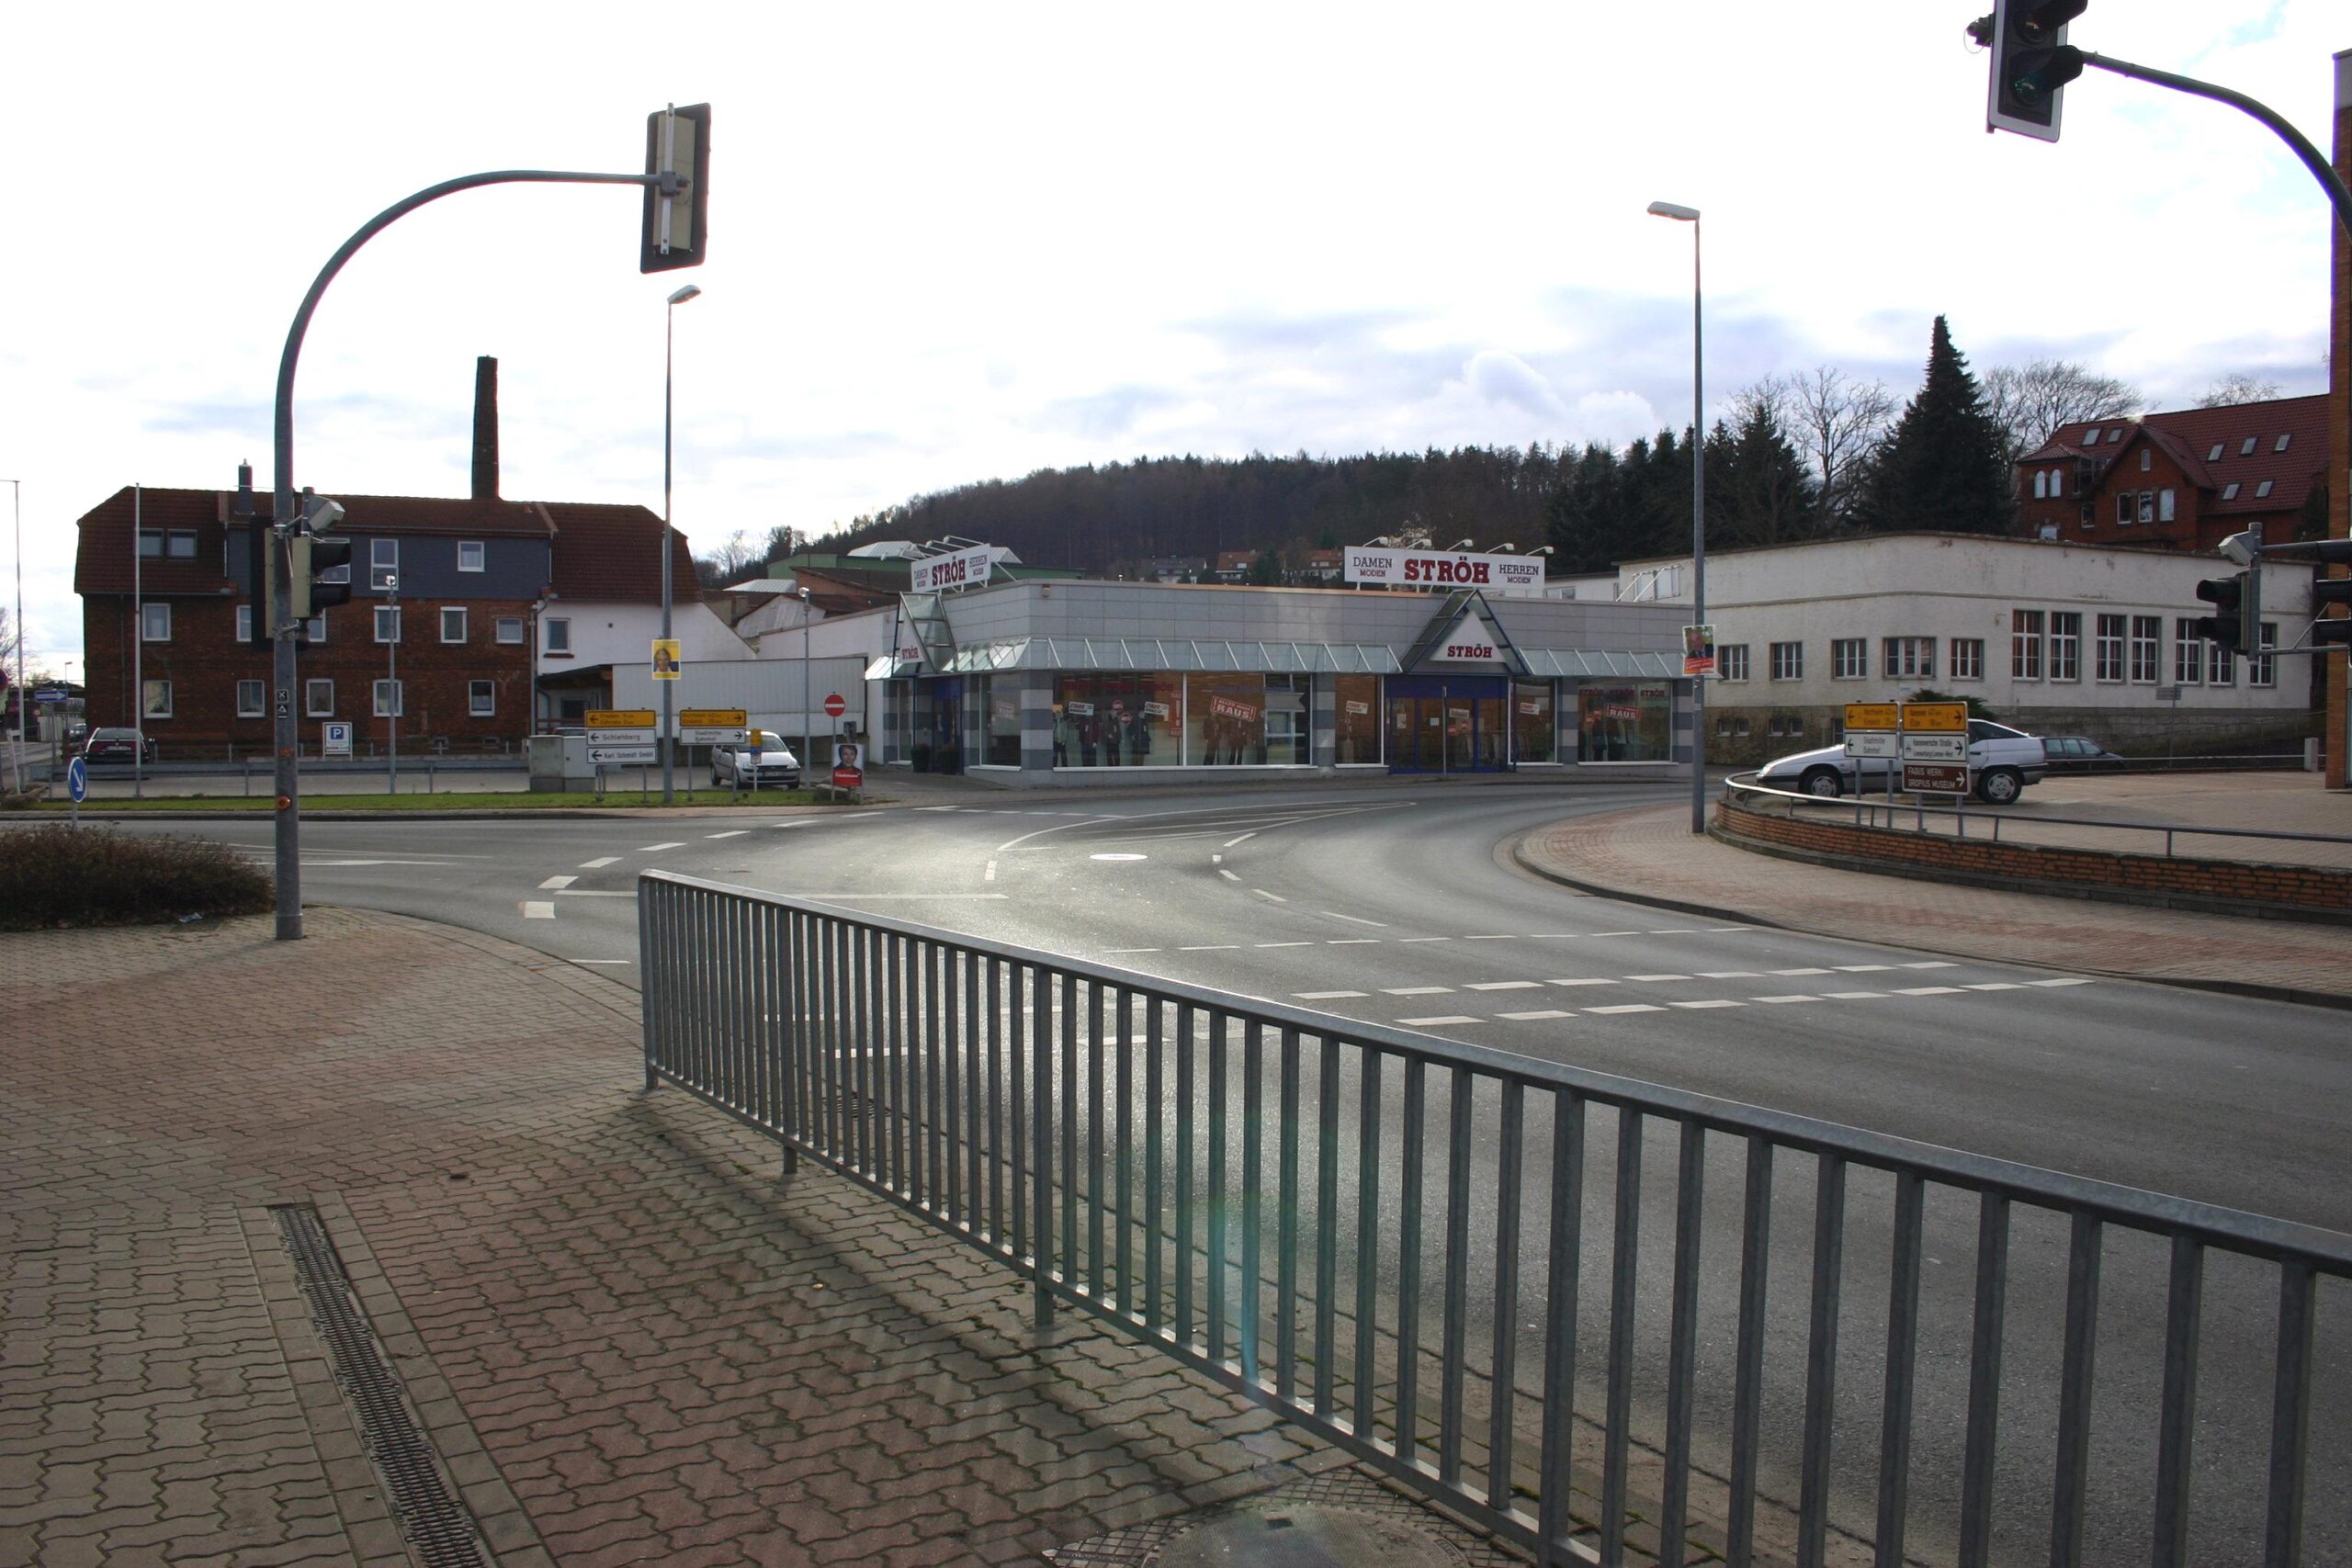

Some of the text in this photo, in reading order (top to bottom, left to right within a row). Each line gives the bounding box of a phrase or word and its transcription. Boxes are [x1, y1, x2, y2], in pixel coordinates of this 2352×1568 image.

[1352, 557, 1393, 569] DAMEN
[932, 556, 967, 586] STRÖH
[1404, 556, 1490, 583] STRÖH
[1499, 564, 1539, 576] HERREN
[1507, 576, 1532, 584] MODEN
[1447, 643, 1493, 659] STRÖH
[334, 728, 342, 738] P
[1908, 766, 1925, 775] FAGUS
[1908, 778, 1955, 789] GROPIUS MUSEUM
